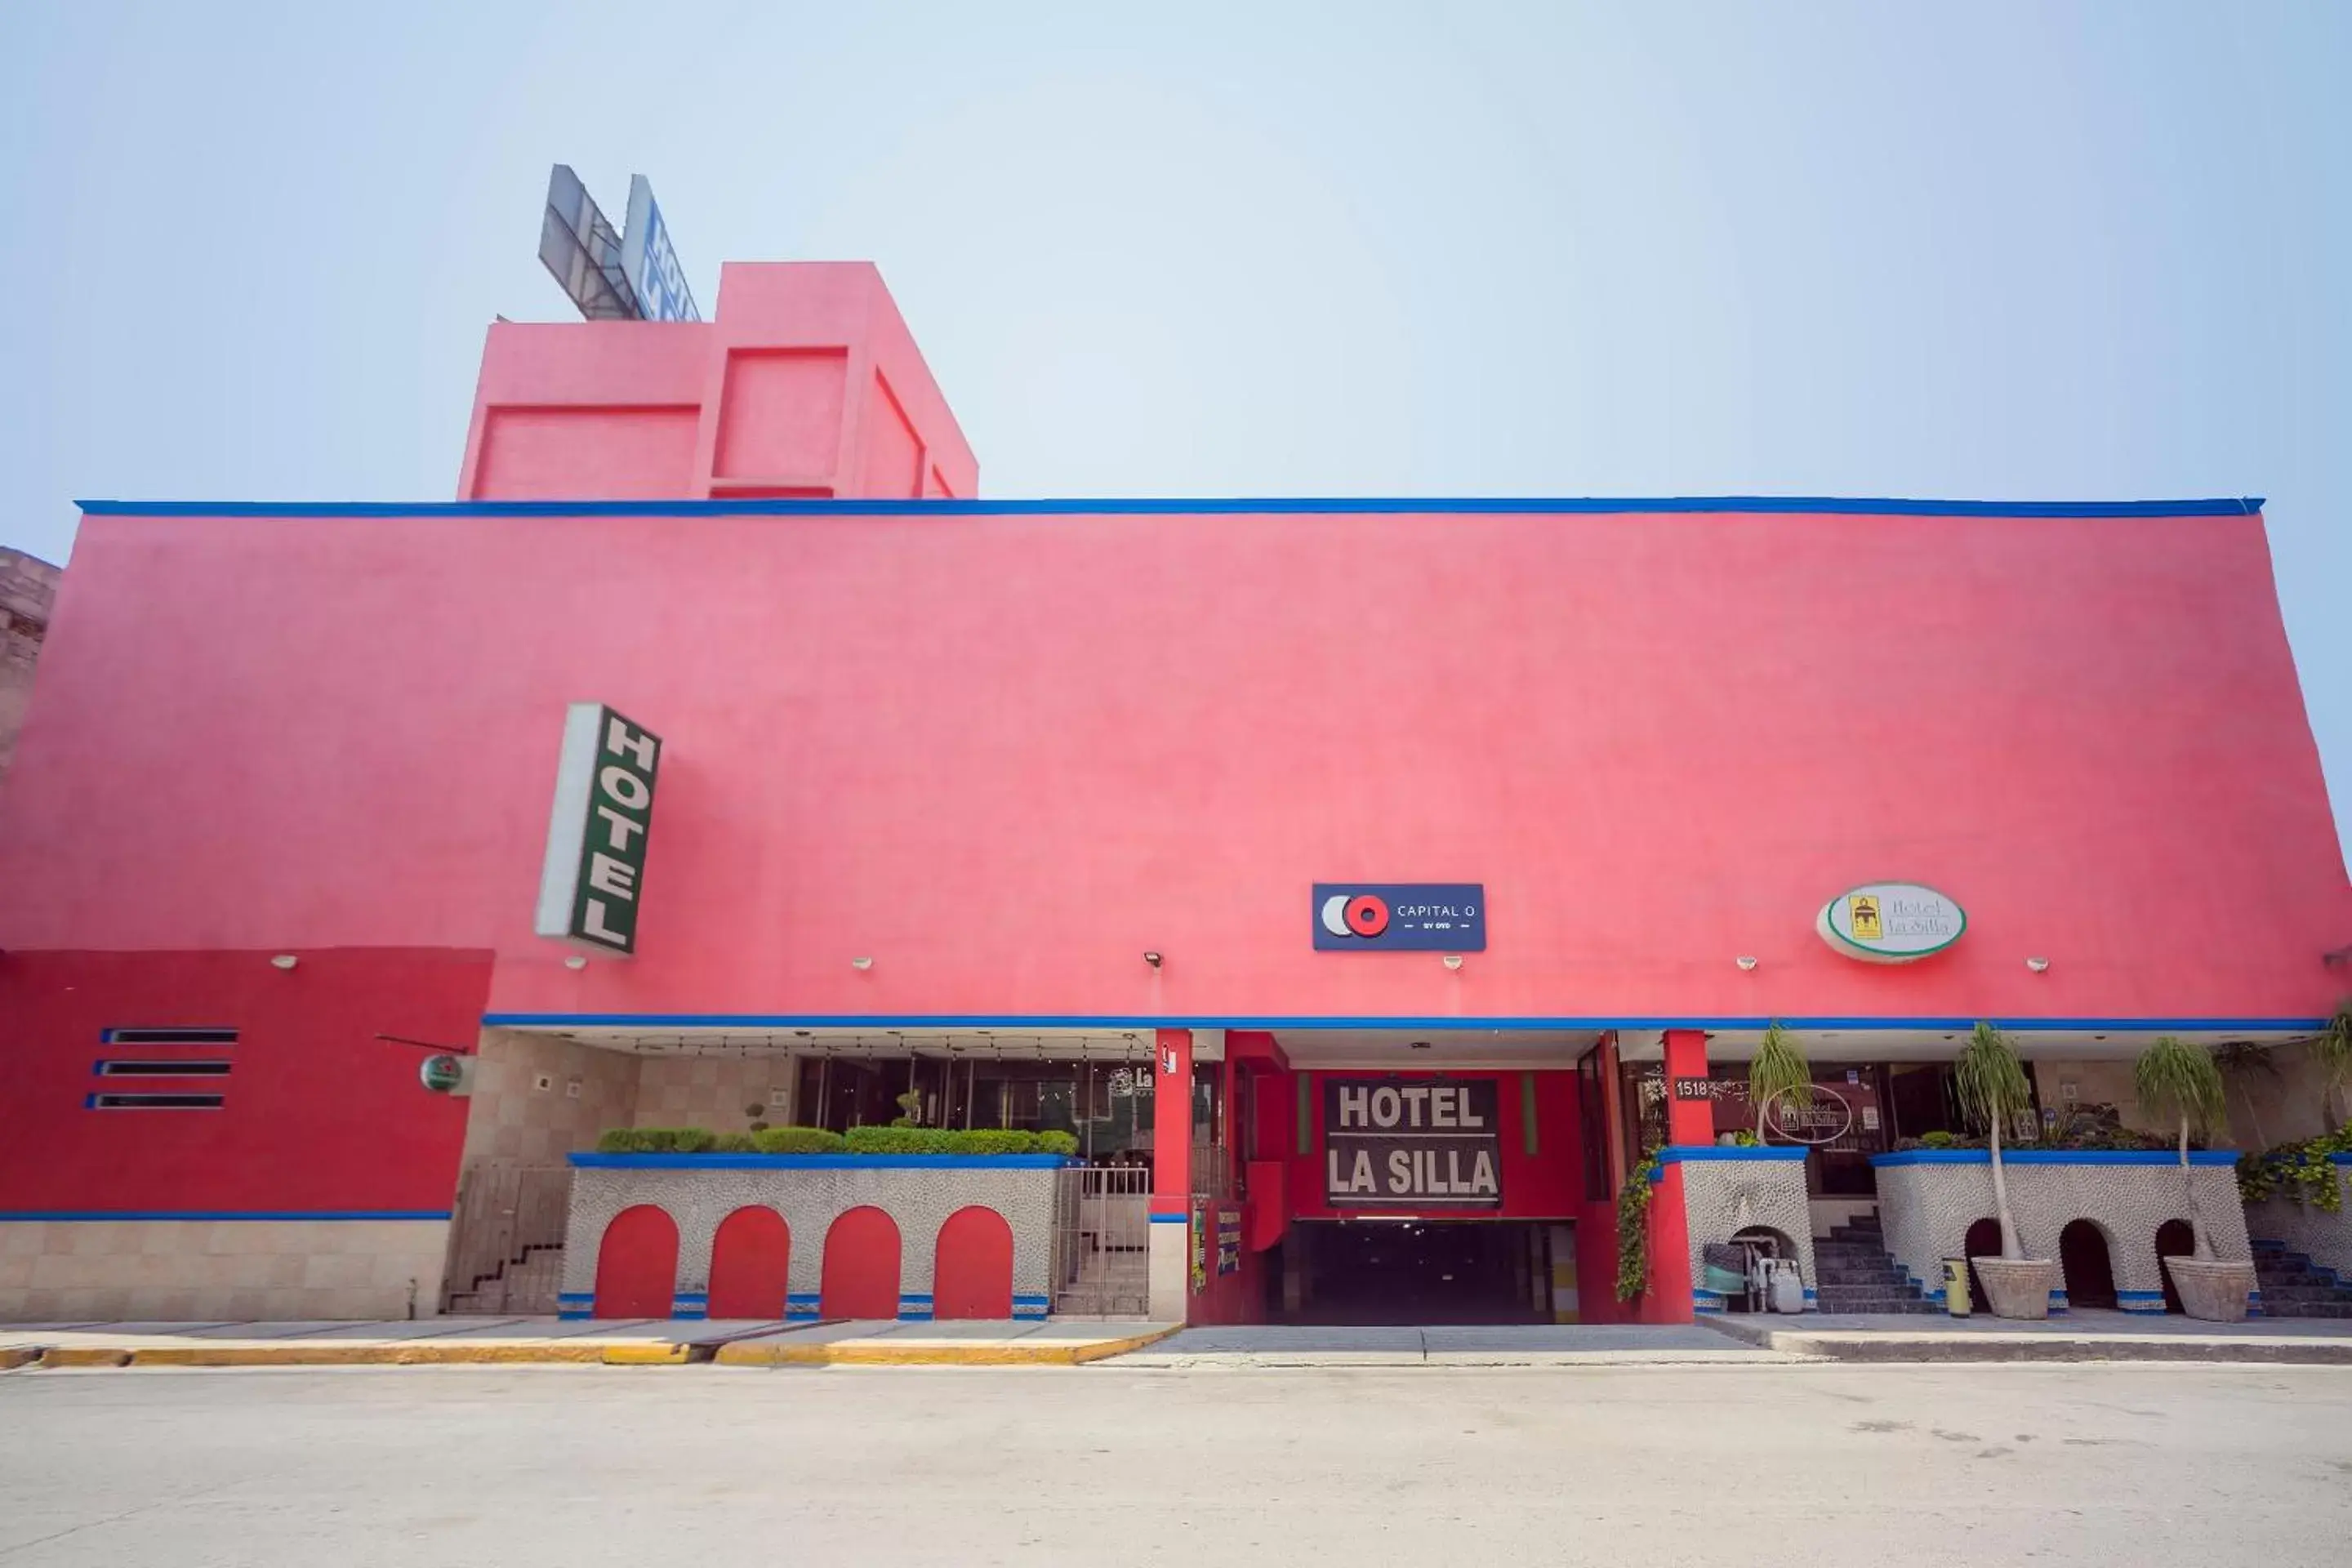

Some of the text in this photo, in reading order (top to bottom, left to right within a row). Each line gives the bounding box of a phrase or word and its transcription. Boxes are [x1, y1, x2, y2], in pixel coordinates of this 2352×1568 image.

[582, 717, 655, 945] HOTEL
[1397, 905, 1476, 916] CAPITAL O
[1339, 1086, 1484, 1127] HOTEL
[1677, 1080, 1708, 1096] 1518
[1329, 1149, 1499, 1194] LA SILLA
